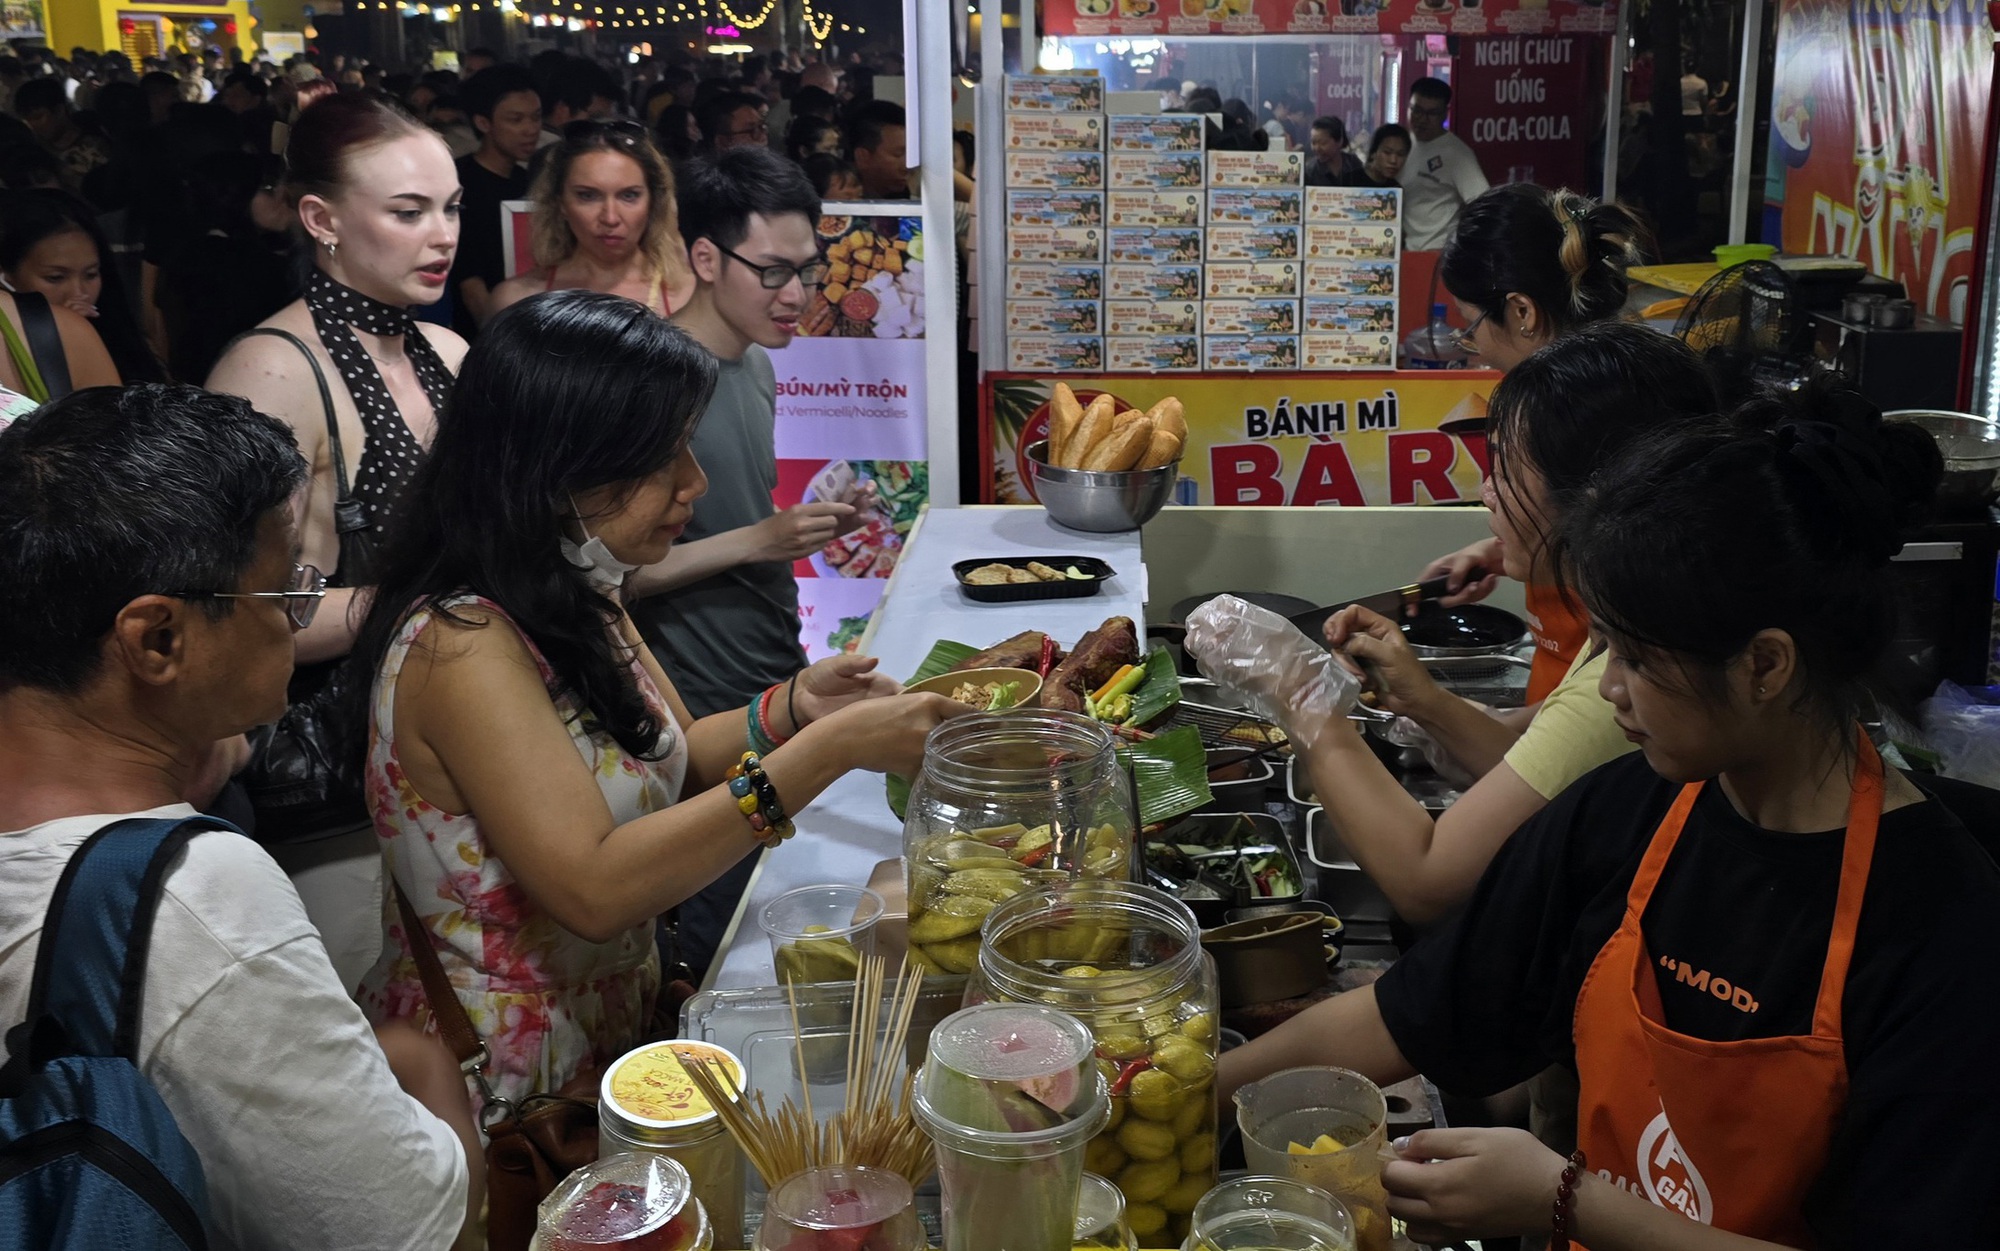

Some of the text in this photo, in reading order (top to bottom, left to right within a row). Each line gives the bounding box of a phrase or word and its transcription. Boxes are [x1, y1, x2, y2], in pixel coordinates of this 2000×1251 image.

[1525, 34, 1573, 64] CHÚT
[1495, 68, 1546, 104] UỐNG
[1472, 115, 1571, 142] COCA-COLA
[855, 378, 908, 402] TRỘN
[1246, 391, 1397, 438] BÁNH MÌ
[1210, 434, 1366, 506] BÀ
